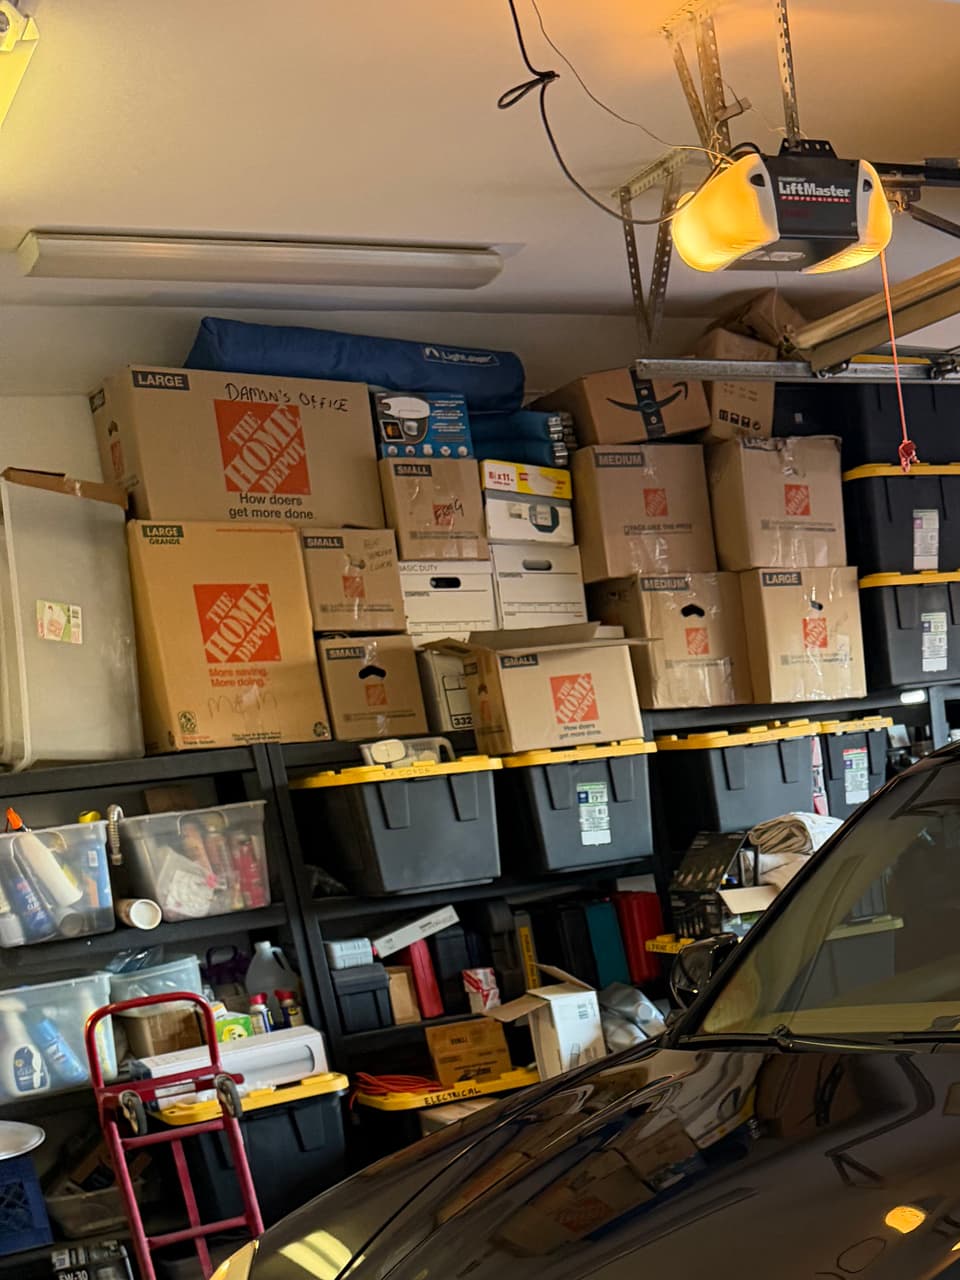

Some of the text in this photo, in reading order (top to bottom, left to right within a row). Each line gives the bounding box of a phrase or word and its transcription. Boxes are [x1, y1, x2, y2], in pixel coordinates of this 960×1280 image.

[778, 181, 851, 197] LiftMaster
[137, 374, 184, 388] LARGE
[227, 411, 261, 446] THE
[224, 404, 303, 492] HOME
[258, 438, 306, 494] DEPOT
[598, 454, 643, 466] MEDIUM
[239, 493, 303, 506] How doers
[228, 507, 249, 519] get
[251, 508, 282, 519] more
[146, 527, 178, 537] LARGE
[765, 574, 799, 585] LARGE
[206, 591, 237, 625] THE
[203, 584, 273, 662] HOME
[235, 611, 277, 661] DEPOT
[503, 655, 537, 666] SMALL
[208, 667, 235, 677] More
[210, 678, 236, 688] More
[554, 673, 591, 722] HOME
[423, 1088, 482, 1105] ELECTRICAL
